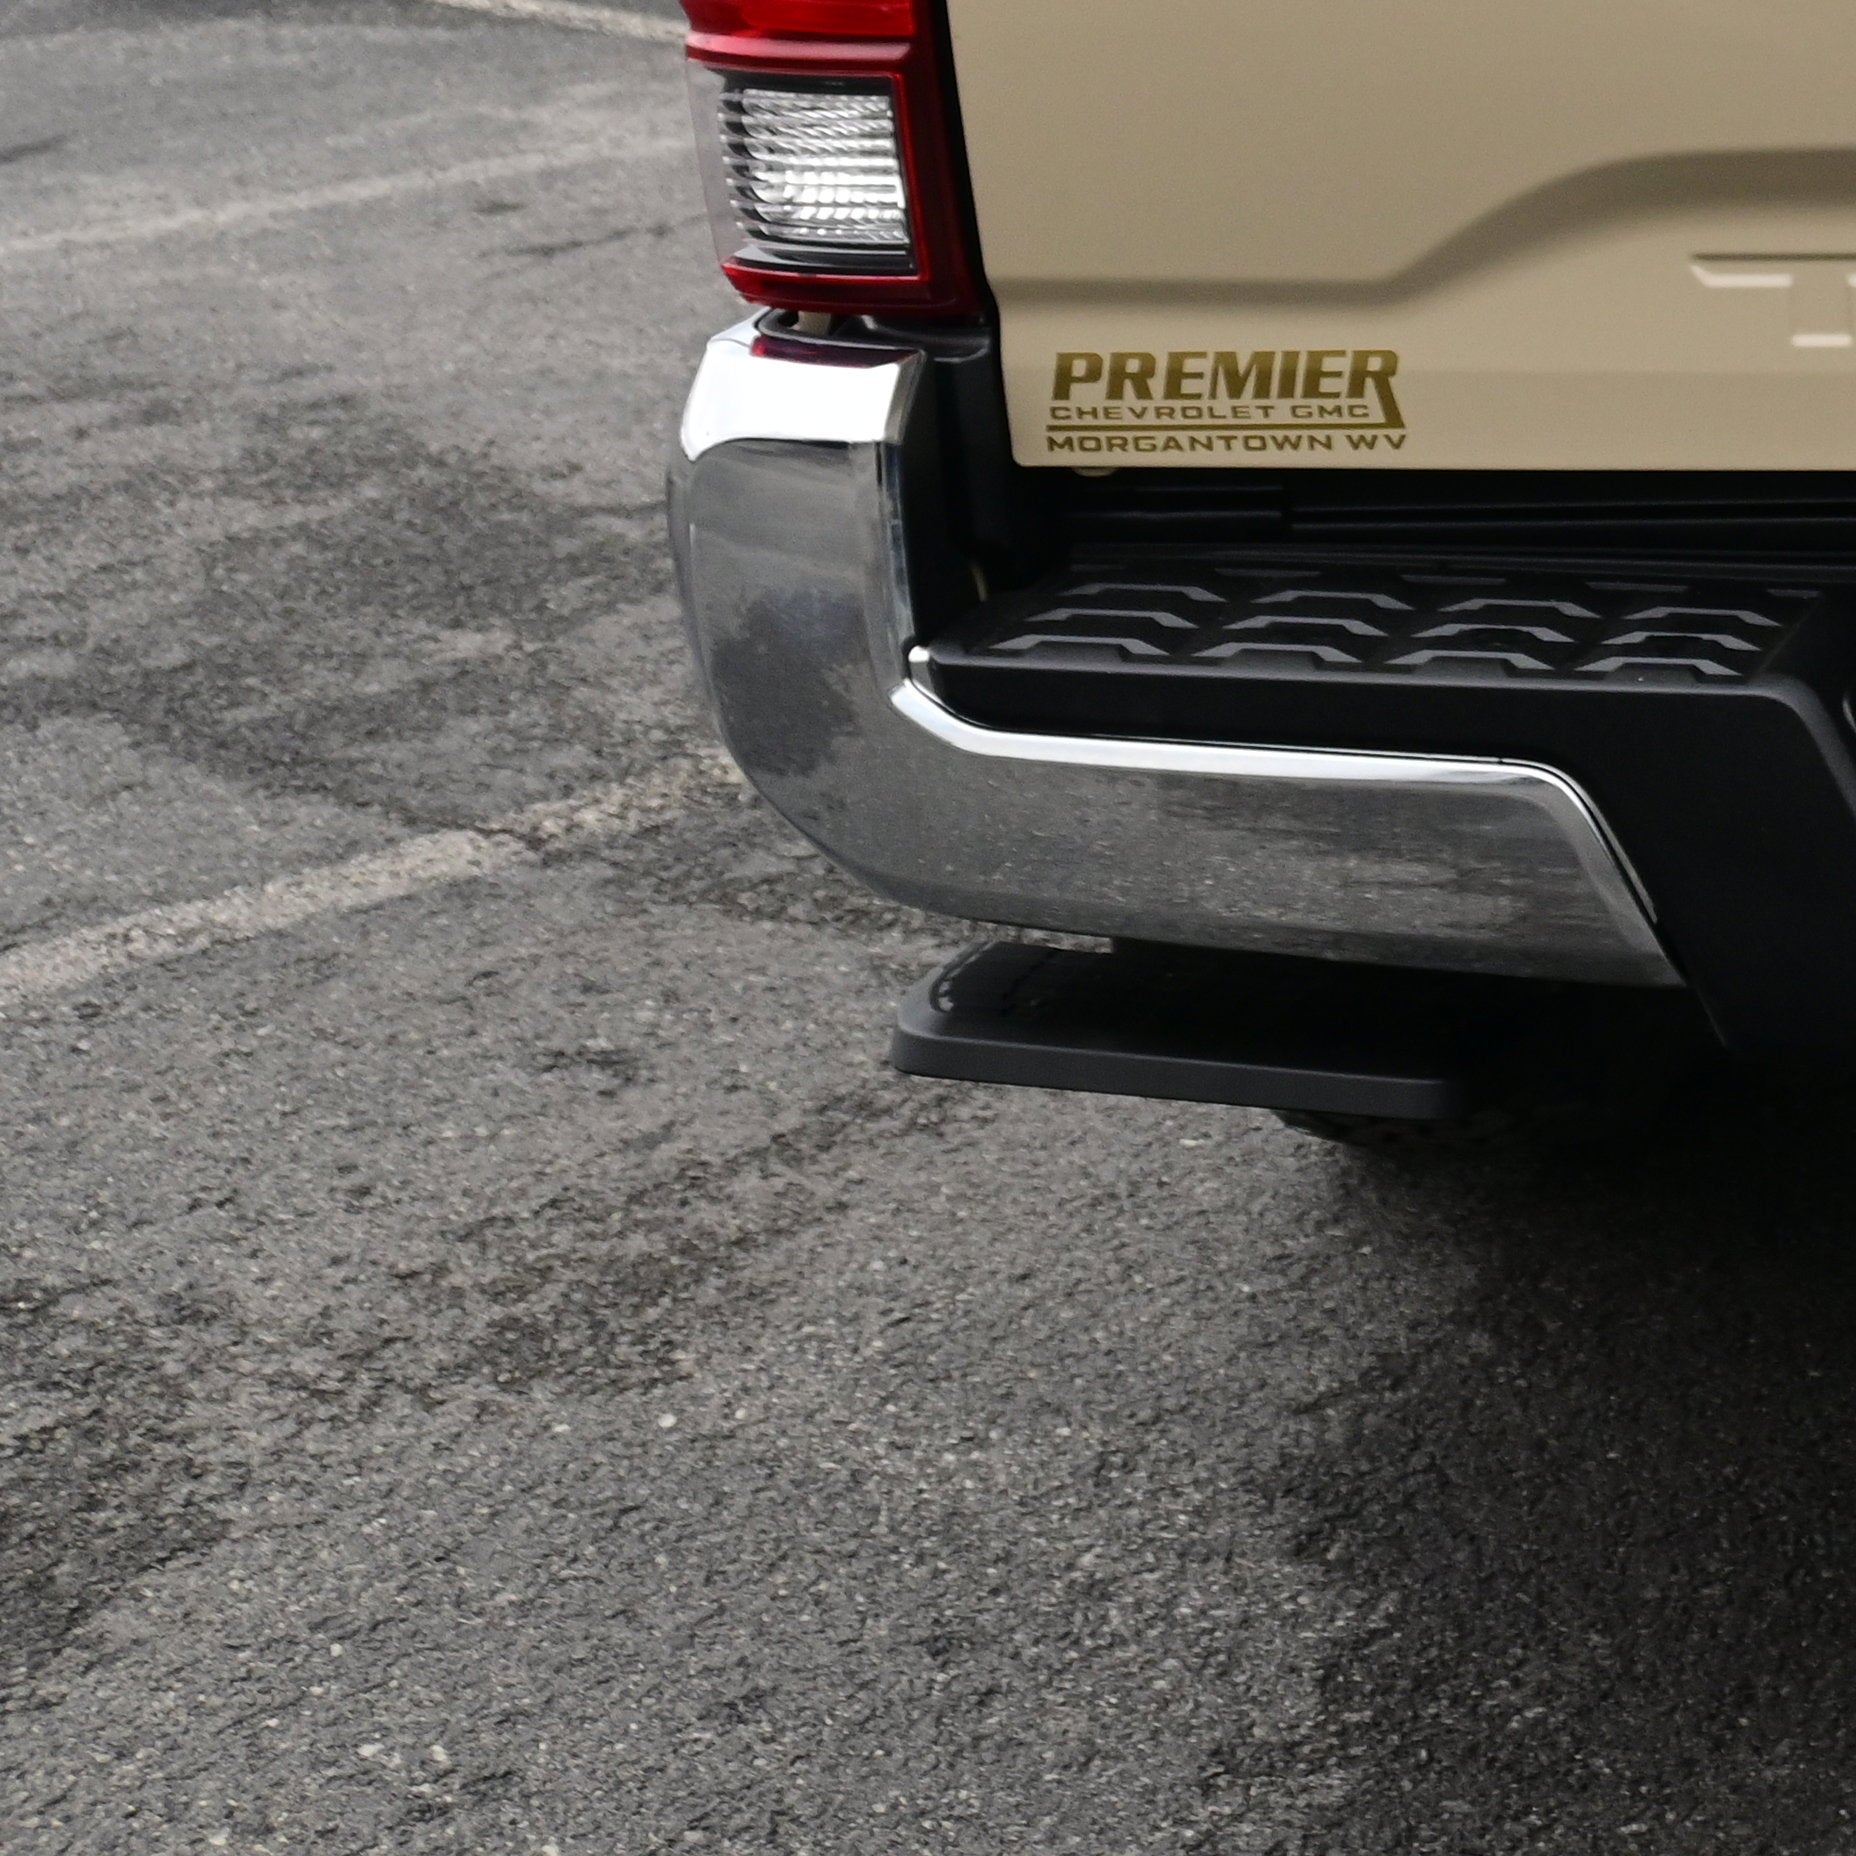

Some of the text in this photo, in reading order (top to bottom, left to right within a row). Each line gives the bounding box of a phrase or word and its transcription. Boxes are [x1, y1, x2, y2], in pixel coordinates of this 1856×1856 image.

[1051, 349, 1406, 429] PREMIER
[1049, 404, 1370, 420] CHEVROLET GMC
[1047, 434, 1406, 453] MORGANTOWN WV
